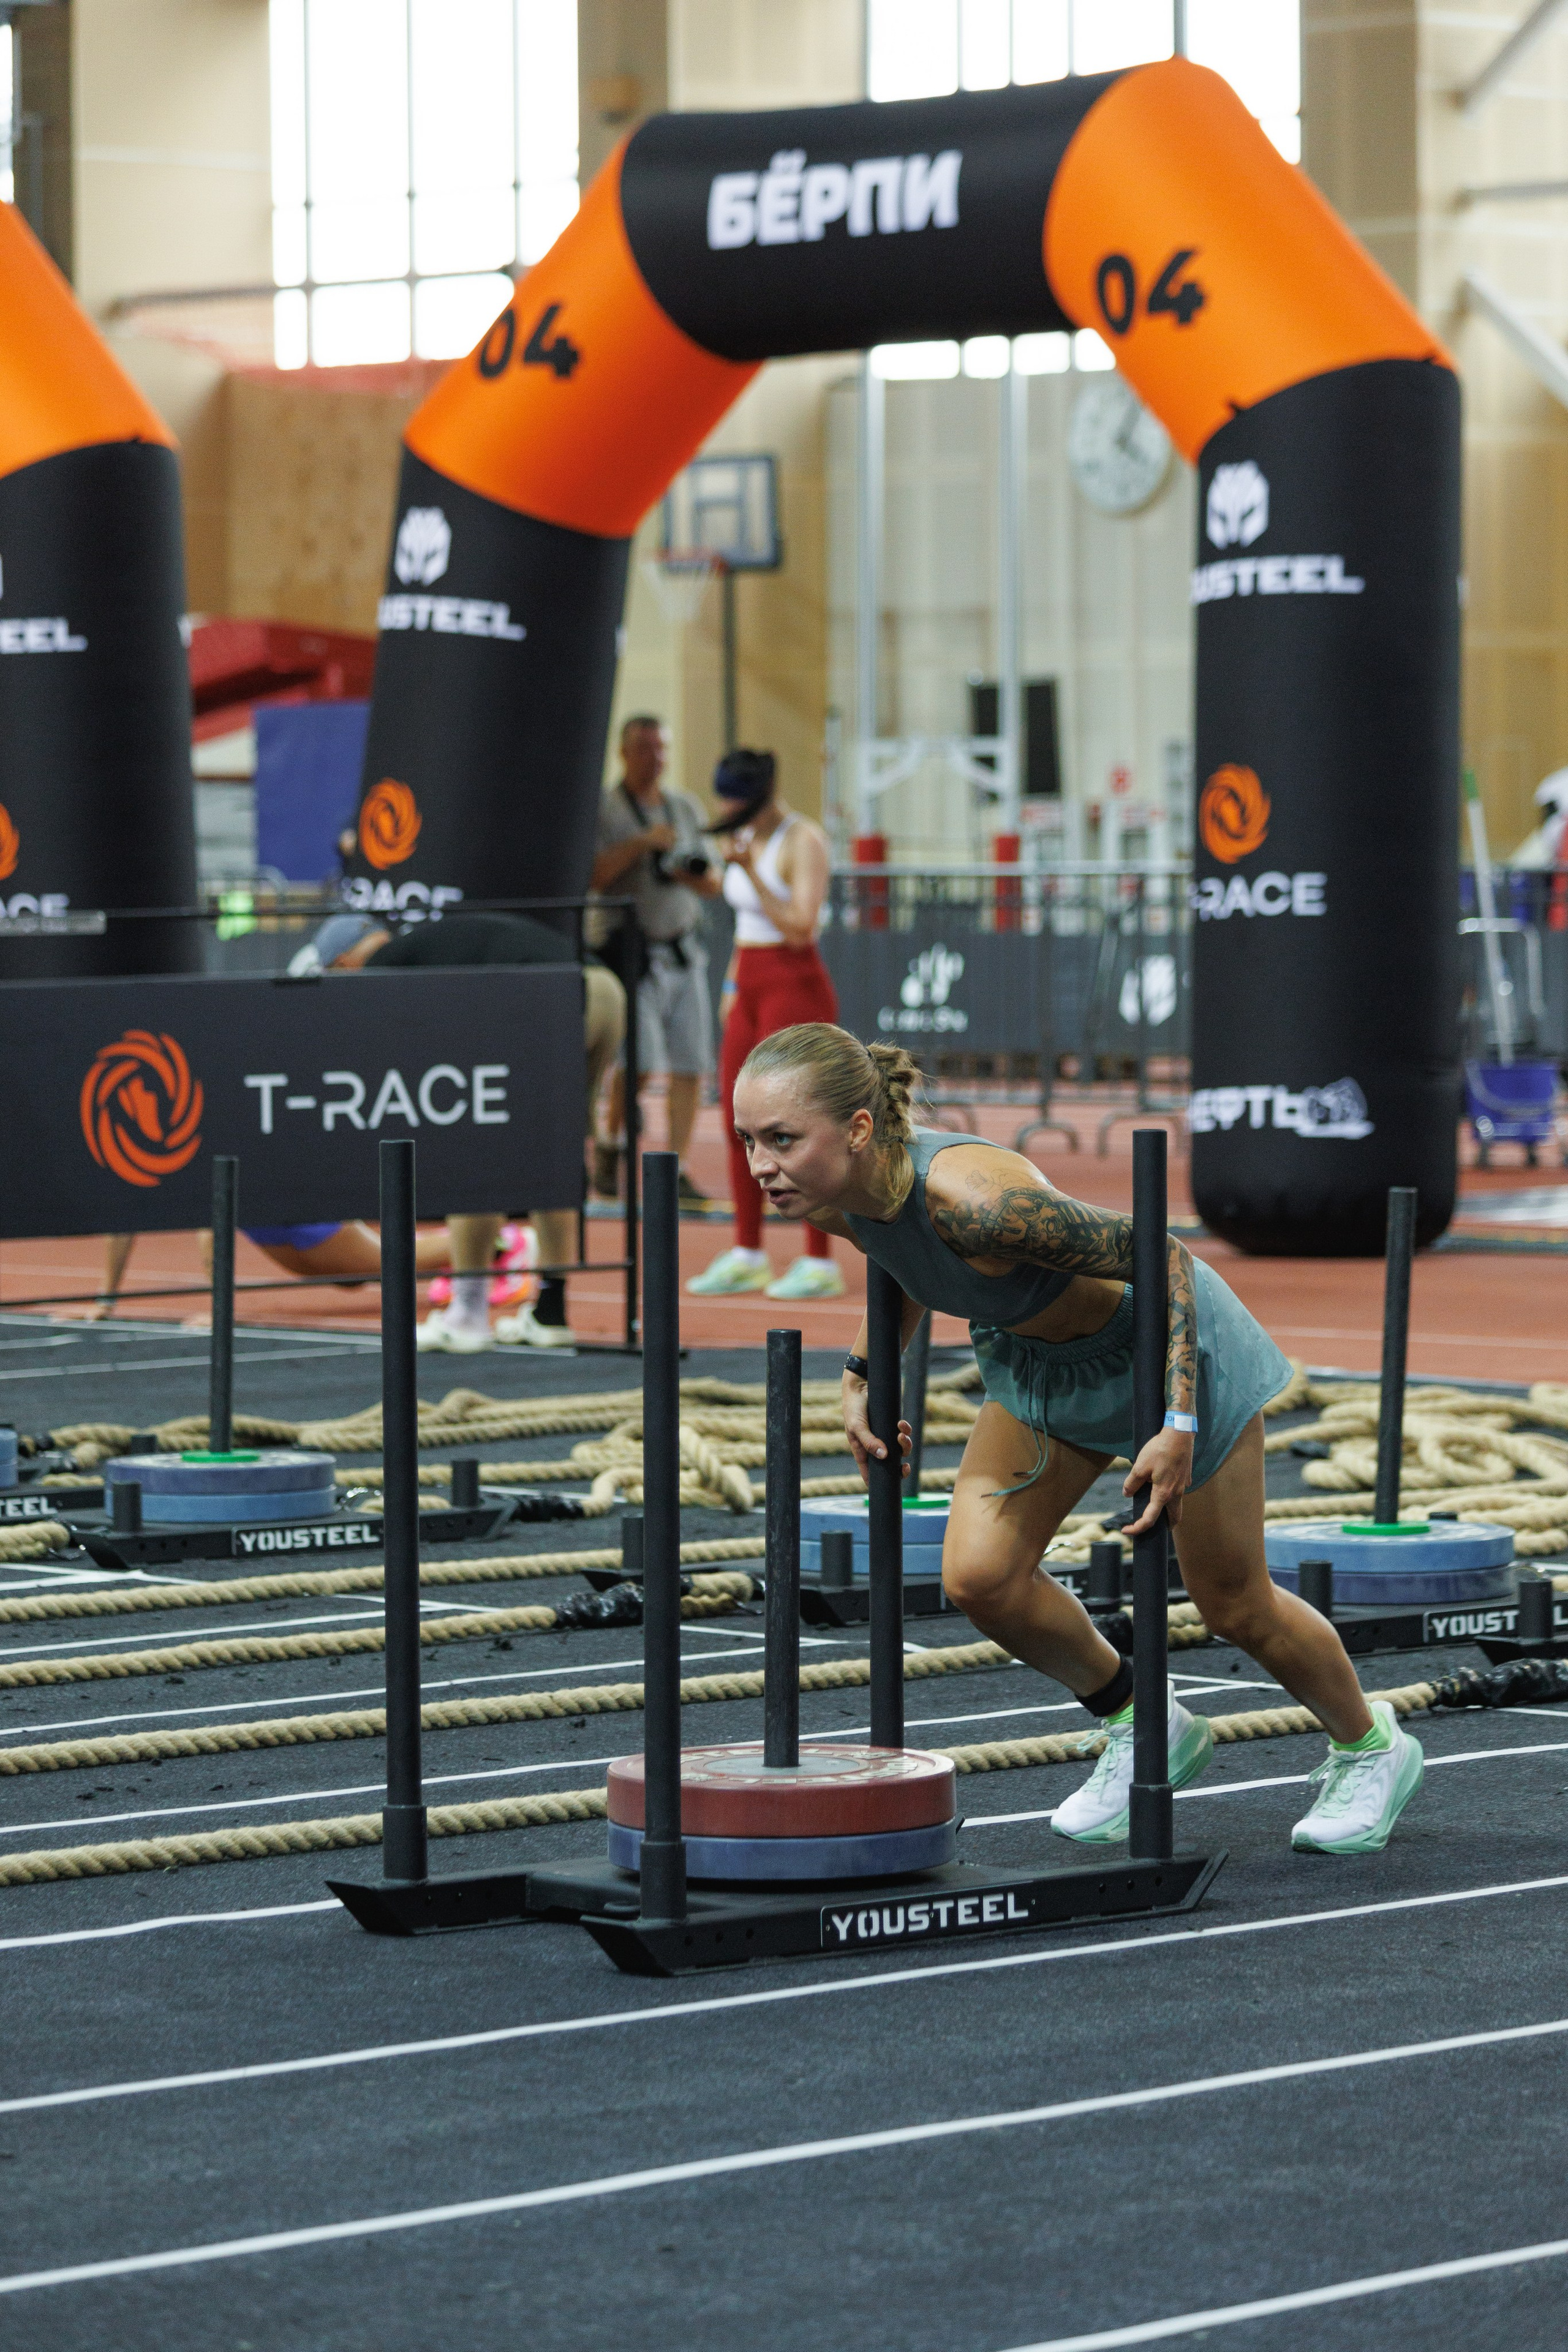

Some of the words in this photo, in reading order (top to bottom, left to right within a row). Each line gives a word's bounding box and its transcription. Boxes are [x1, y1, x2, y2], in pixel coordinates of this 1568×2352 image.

[707, 147, 963, 251] БЁРПИ
[1095, 247, 1207, 335] 04
[478, 304, 580, 380] 04
[244, 1063, 510, 1135] T-RACE
[239, 1524, 380, 1553] YOUSTEEL
[1431, 1604, 1568, 1638] YOUSTL
[831, 1891, 1029, 1941] YOUSTEEL
